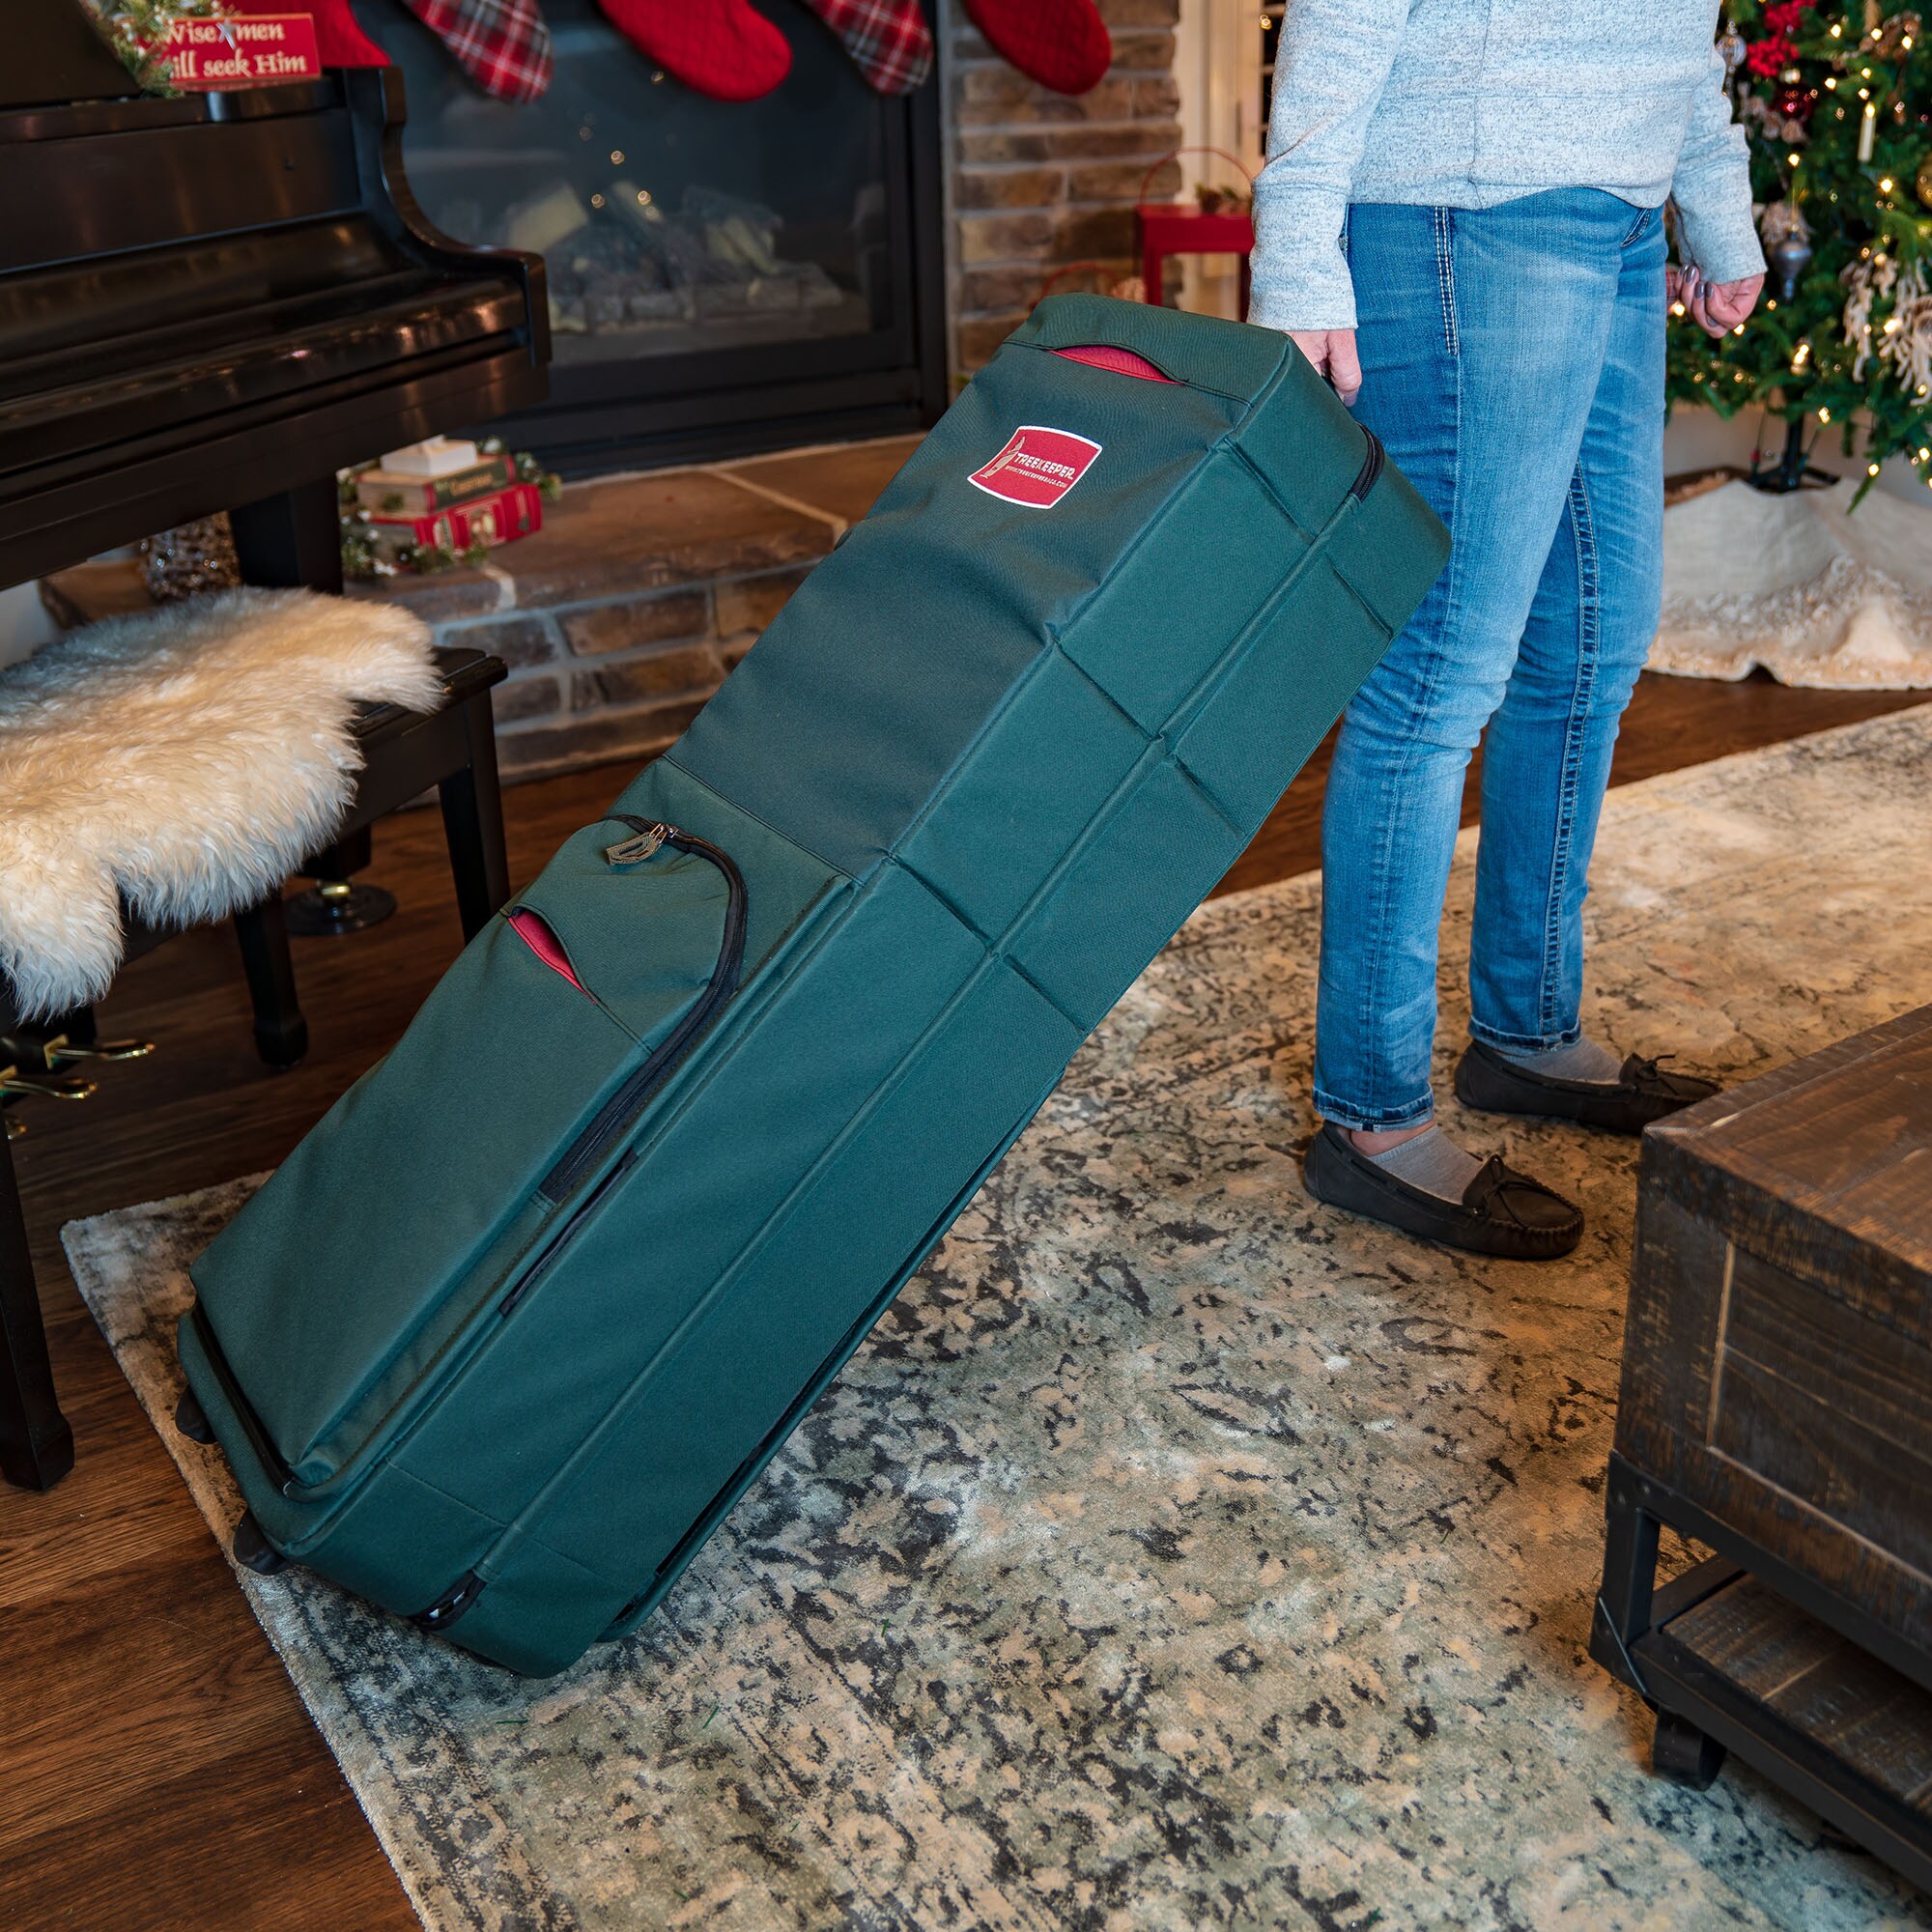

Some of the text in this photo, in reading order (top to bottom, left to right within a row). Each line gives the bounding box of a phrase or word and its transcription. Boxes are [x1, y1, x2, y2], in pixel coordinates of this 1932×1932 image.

[237, 22, 285, 42] men
[203, 46, 252, 78] seek
[253, 50, 308, 74] Him
[1014, 452, 1075, 480] TREEKEEPER
